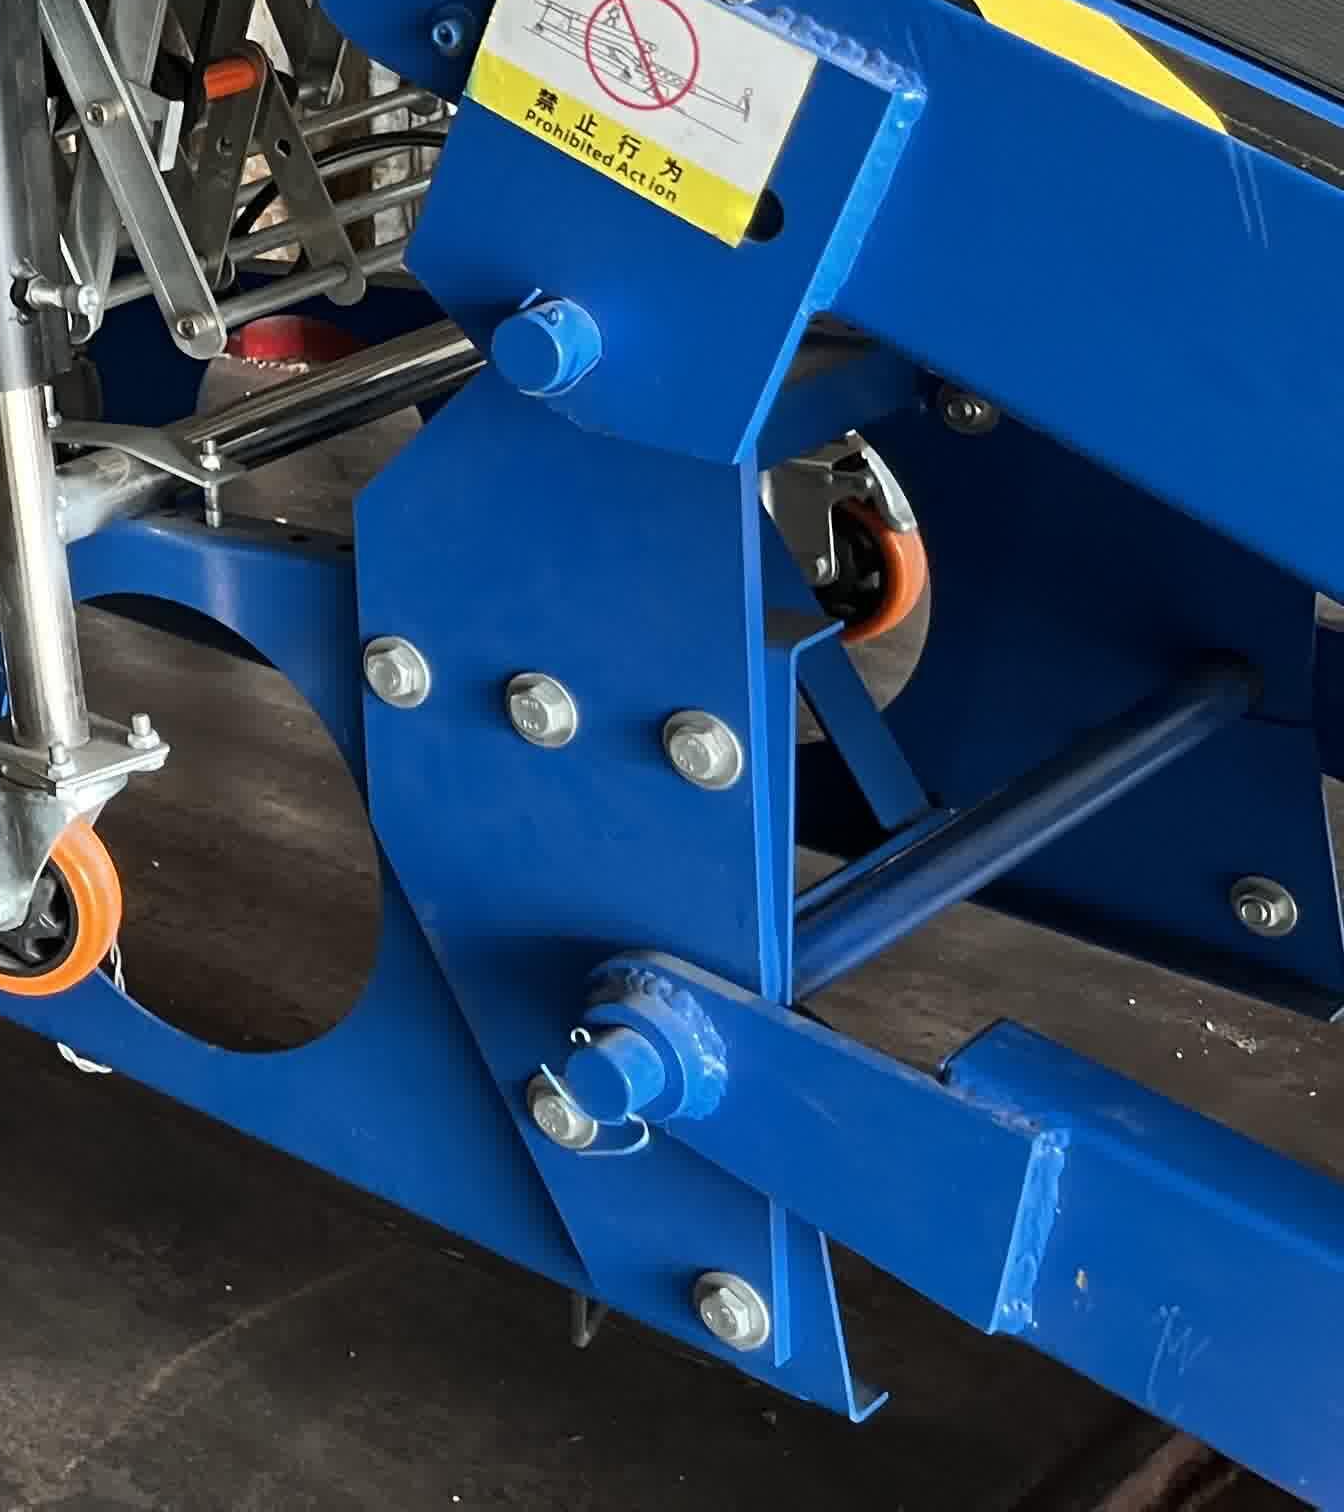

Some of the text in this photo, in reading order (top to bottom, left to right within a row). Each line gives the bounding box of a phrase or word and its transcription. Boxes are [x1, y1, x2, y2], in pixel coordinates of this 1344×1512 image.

[525, 109, 677, 203] Prohibited Action
[534, 87, 683, 184] 禁止行为
